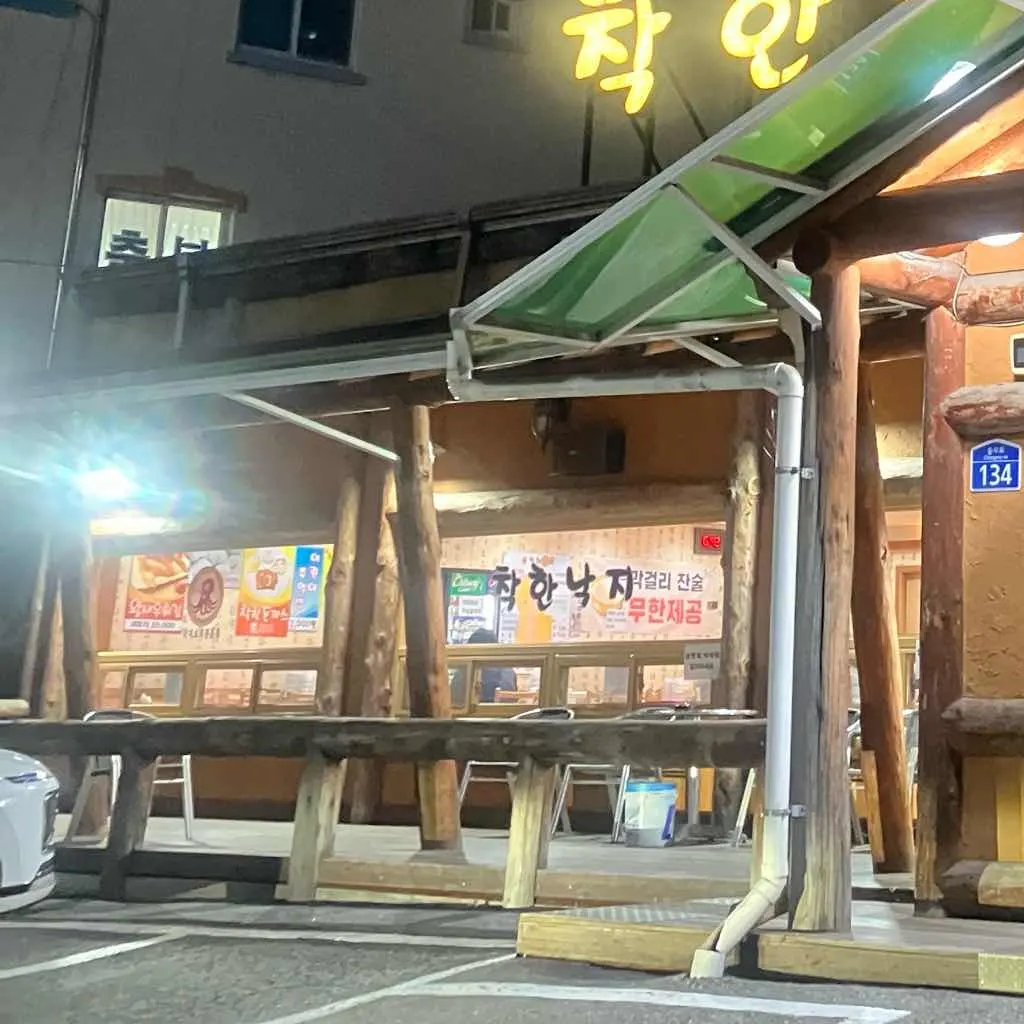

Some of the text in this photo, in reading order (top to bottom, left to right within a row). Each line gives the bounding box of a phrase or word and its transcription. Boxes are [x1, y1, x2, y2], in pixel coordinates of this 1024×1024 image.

[979, 463, 1013, 487] 134
[493, 561, 634, 612] 착한낙지
[677, 572, 704, 592] 잔술
[628, 598, 703, 625] 무한제공
